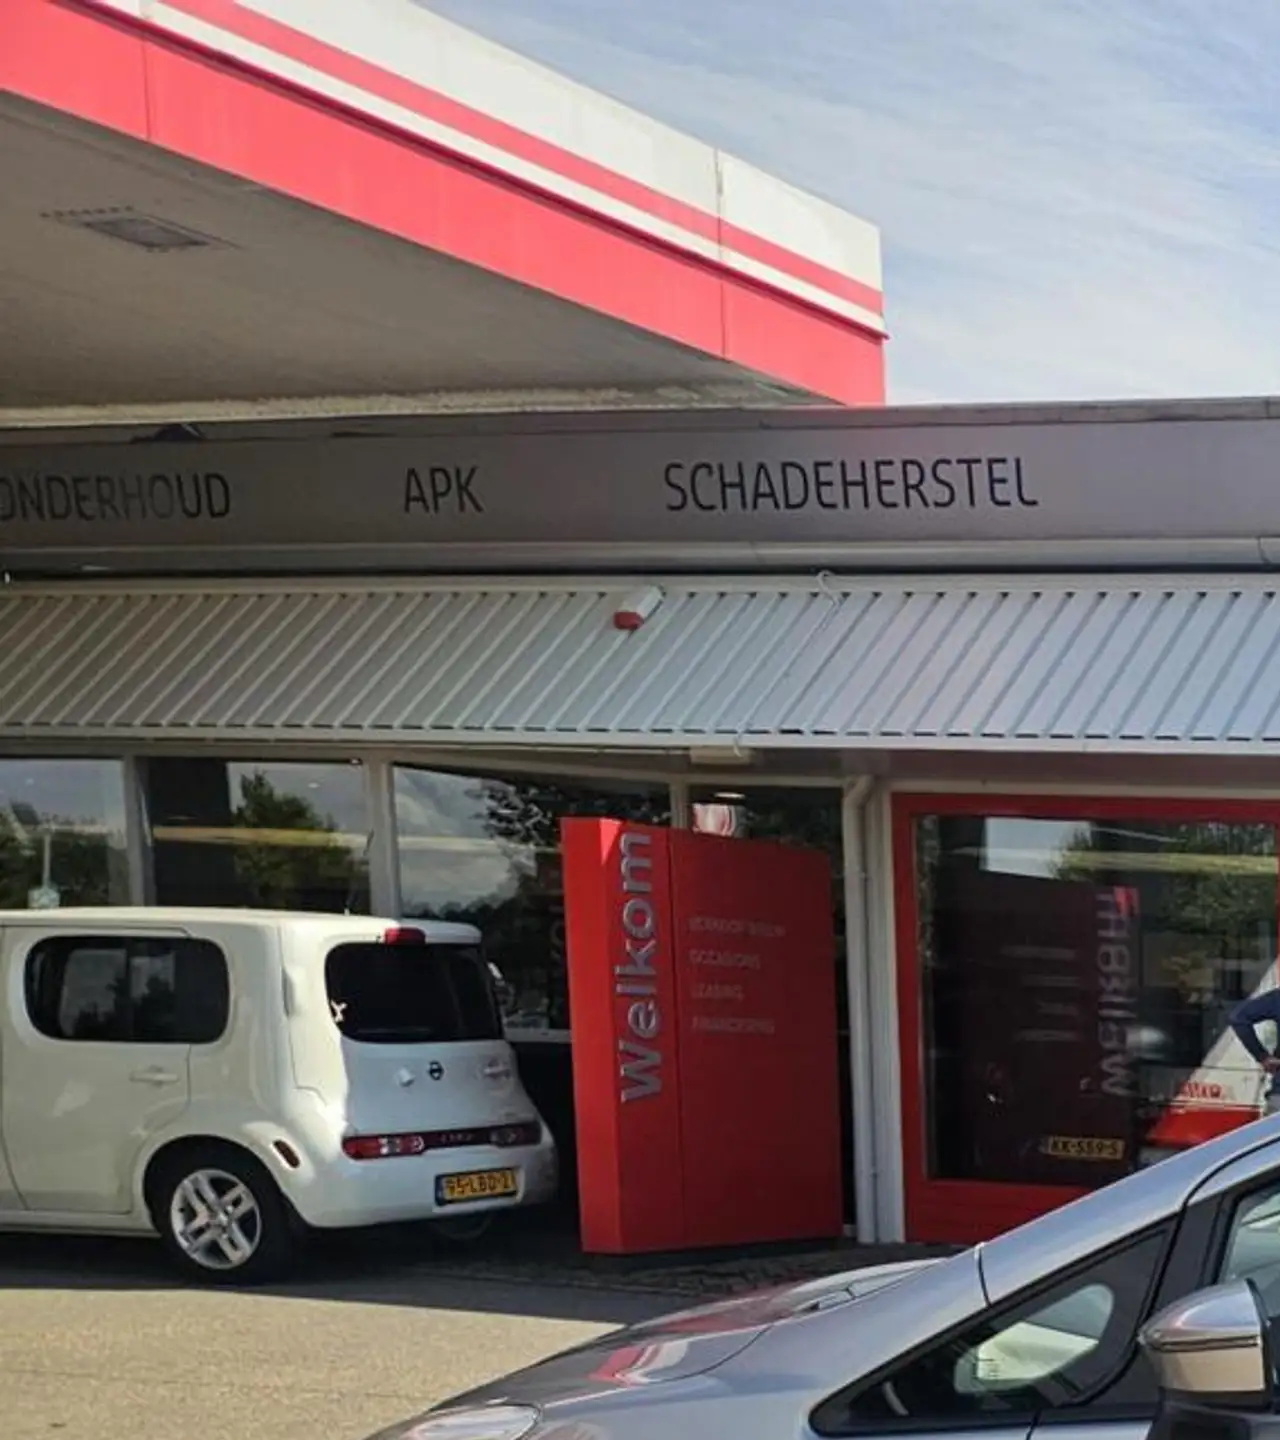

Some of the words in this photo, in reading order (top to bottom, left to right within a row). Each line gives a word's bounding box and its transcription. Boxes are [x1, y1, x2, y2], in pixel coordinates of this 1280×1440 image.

[0, 472, 231, 522] ONDERHOUD
[403, 465, 484, 514] APK
[663, 457, 1040, 511] SCHADEHERSTEL
[614, 830, 663, 1104] Welkom
